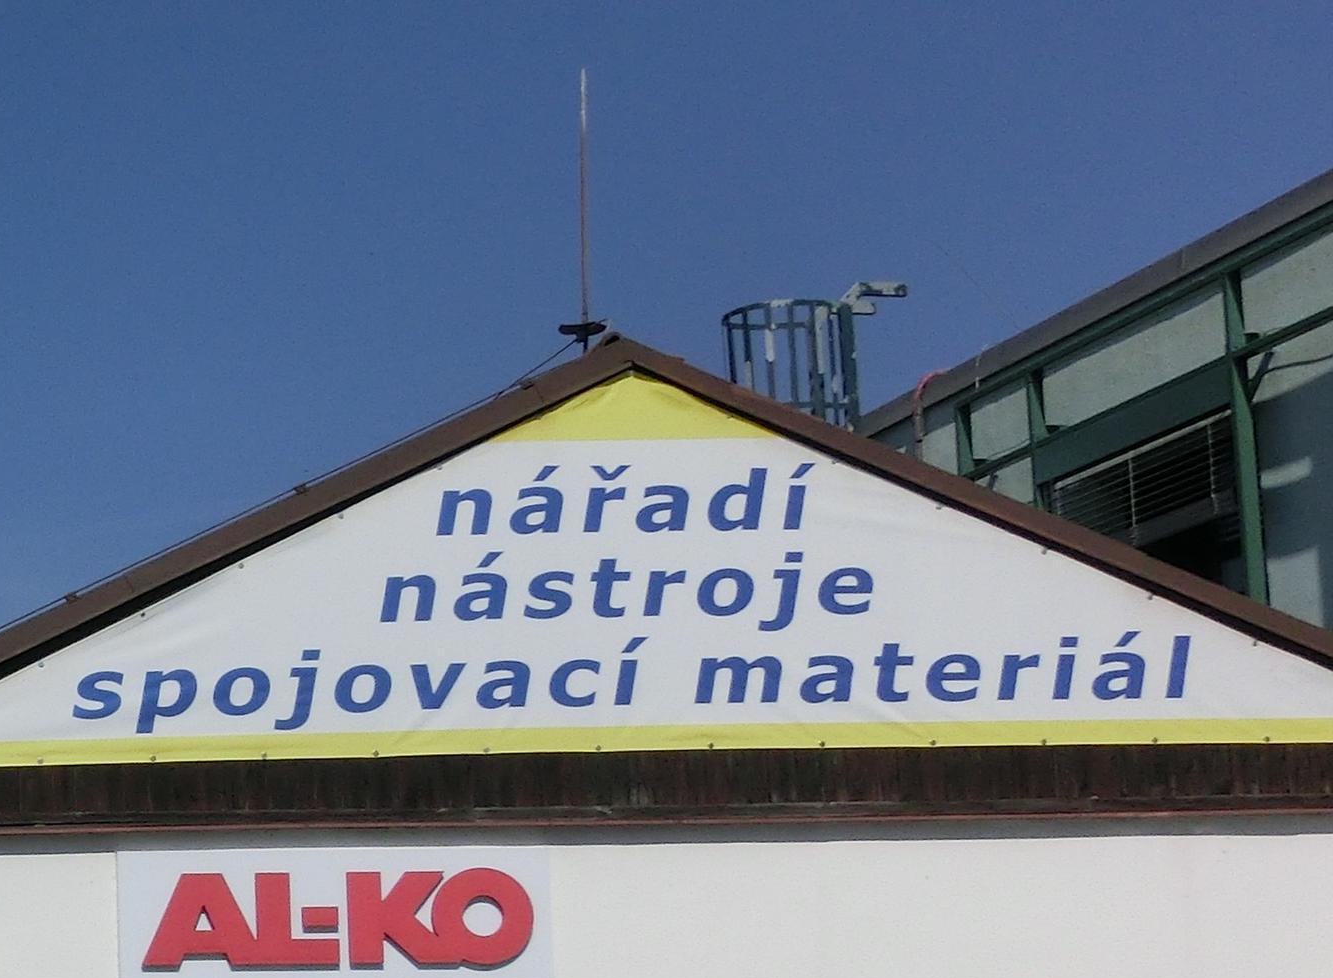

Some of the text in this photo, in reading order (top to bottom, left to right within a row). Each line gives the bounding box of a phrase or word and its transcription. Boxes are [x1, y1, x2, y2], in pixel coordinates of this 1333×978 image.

[438, 464, 811, 535] nářadí
[381, 552, 874, 630] nástroje
[74, 632, 1190, 732] spojovací materiál
[141, 867, 534, 972] AL-KO
